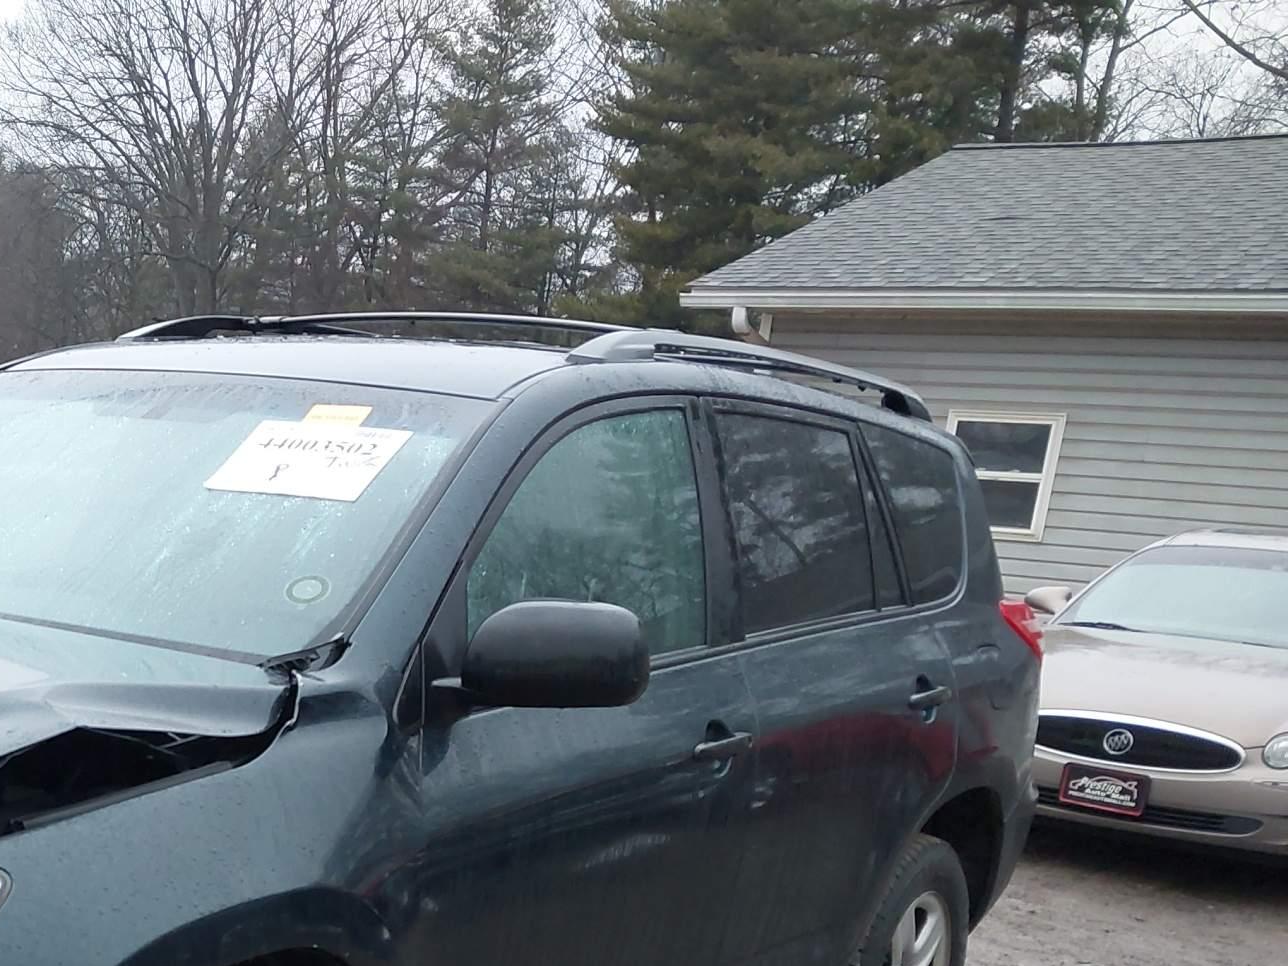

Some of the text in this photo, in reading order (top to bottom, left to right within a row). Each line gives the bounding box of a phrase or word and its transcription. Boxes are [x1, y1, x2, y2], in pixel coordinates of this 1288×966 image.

[258, 437, 379, 456] 44003502
[1078, 776, 1123, 795] Prestige
[1084, 787, 1131, 802] Auto Mall
